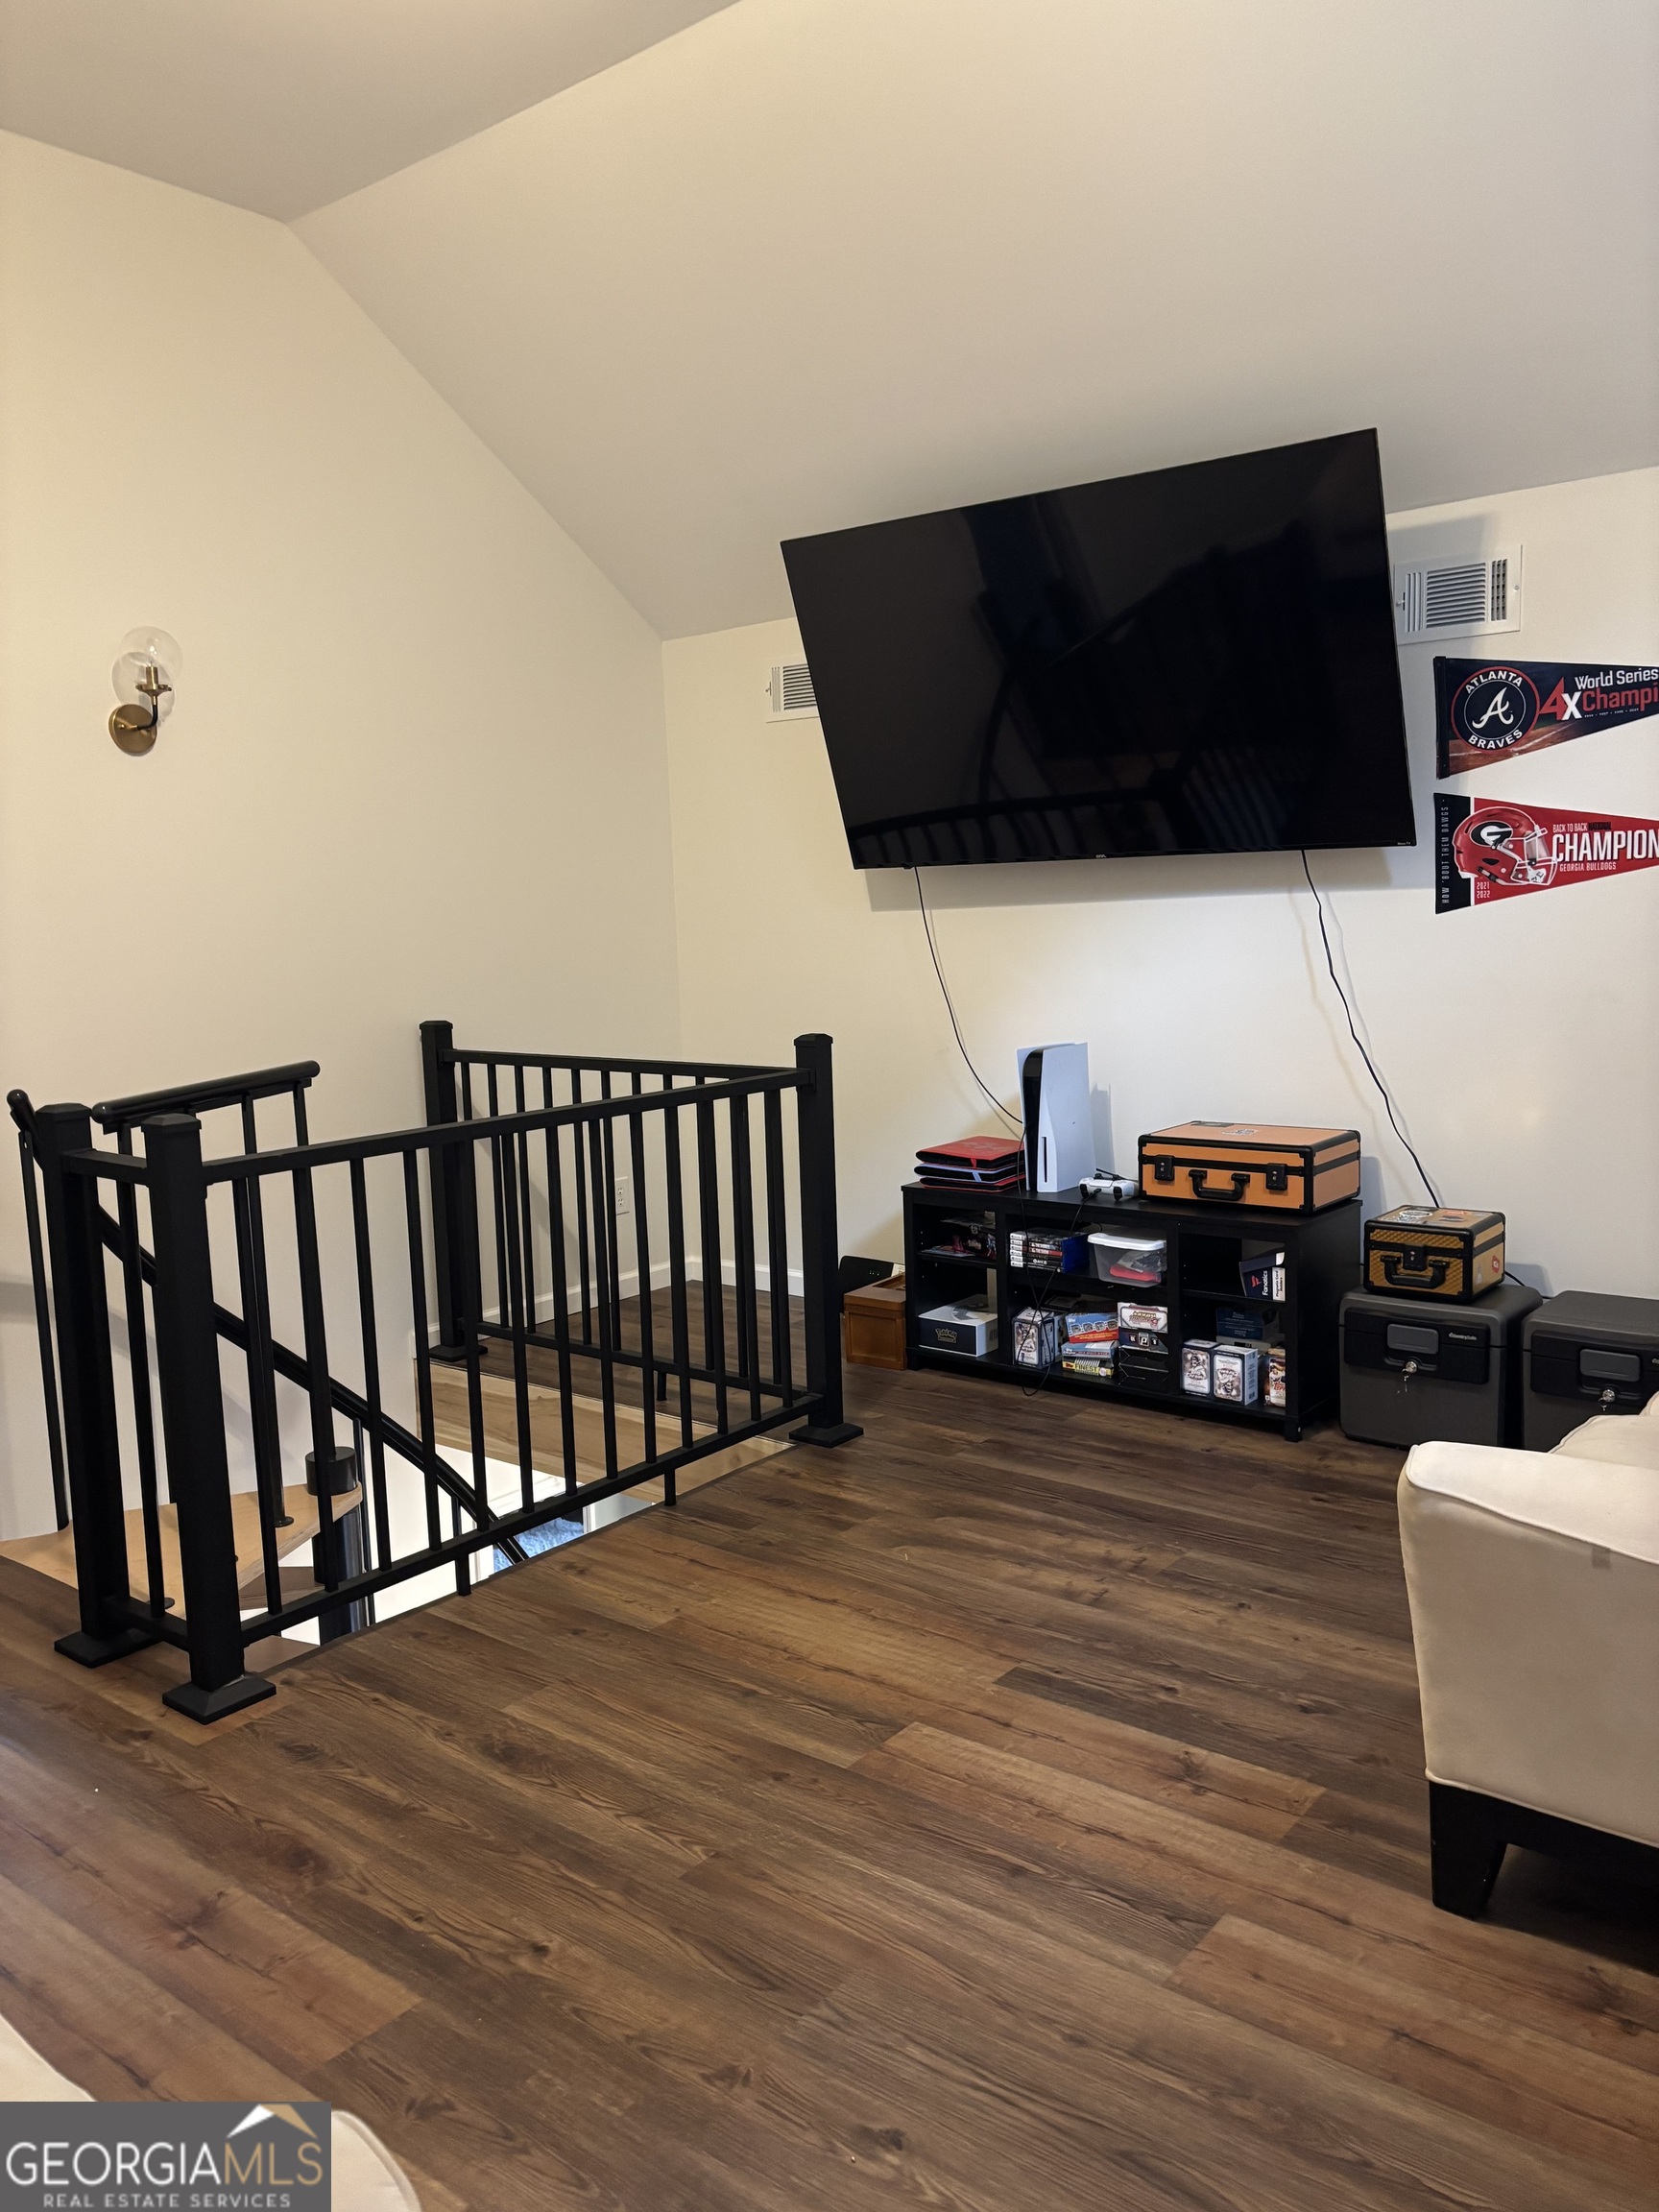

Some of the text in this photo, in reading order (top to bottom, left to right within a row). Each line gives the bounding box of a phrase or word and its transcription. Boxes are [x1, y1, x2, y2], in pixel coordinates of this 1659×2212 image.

[1465, 670, 1523, 694] ATLANTA
[1575, 667, 1659, 690] World Series
[1468, 730, 1523, 749] BRAVES
[1552, 824, 1566, 833] BACK
[1567, 823, 1574, 832] TO
[1575, 823, 1588, 832] BACK
[1441, 837, 1450, 856] THEM
[1559, 862, 1617, 873] GEORGIA BULLDOGS
[1441, 887, 1450, 904] HOW
